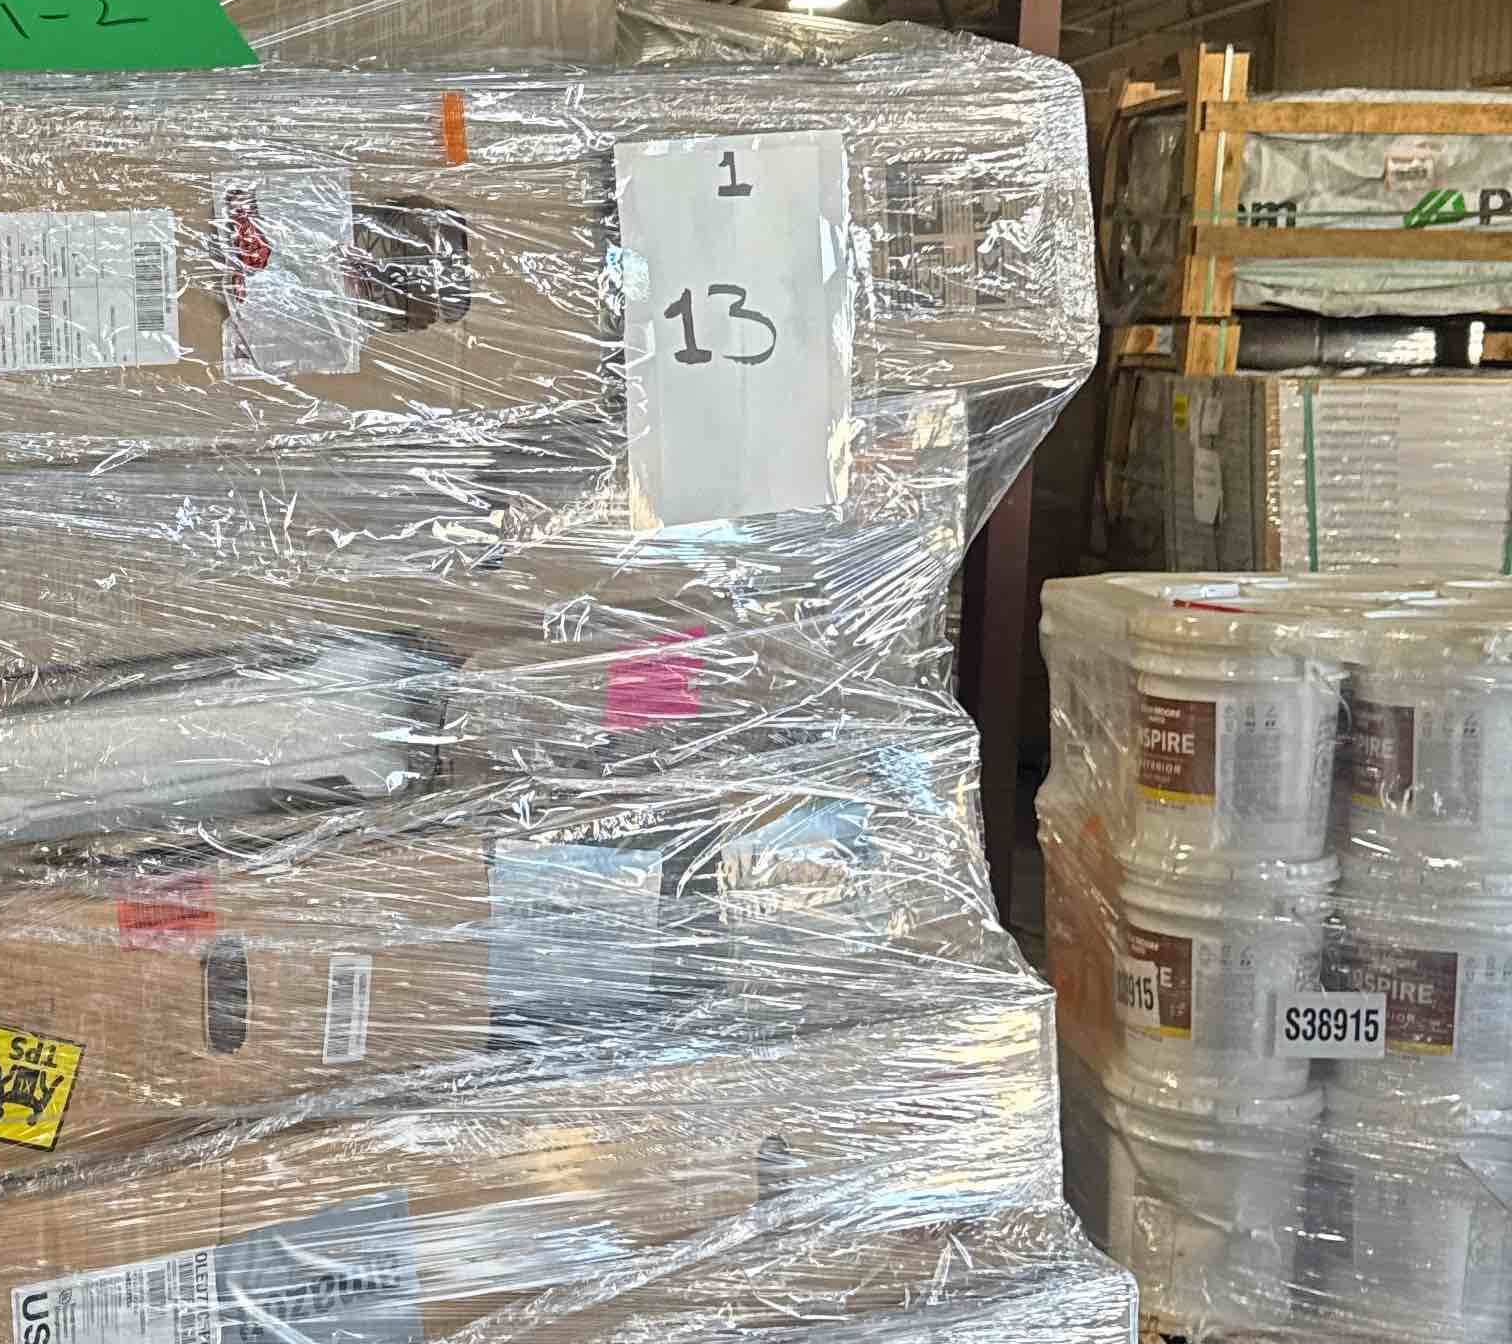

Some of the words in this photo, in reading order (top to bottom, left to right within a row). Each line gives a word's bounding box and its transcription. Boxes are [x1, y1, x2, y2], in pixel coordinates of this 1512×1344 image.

[717, 151, 753, 197] 1
[663, 283, 778, 366] 13
[1284, 1007, 1380, 1043] S38915
